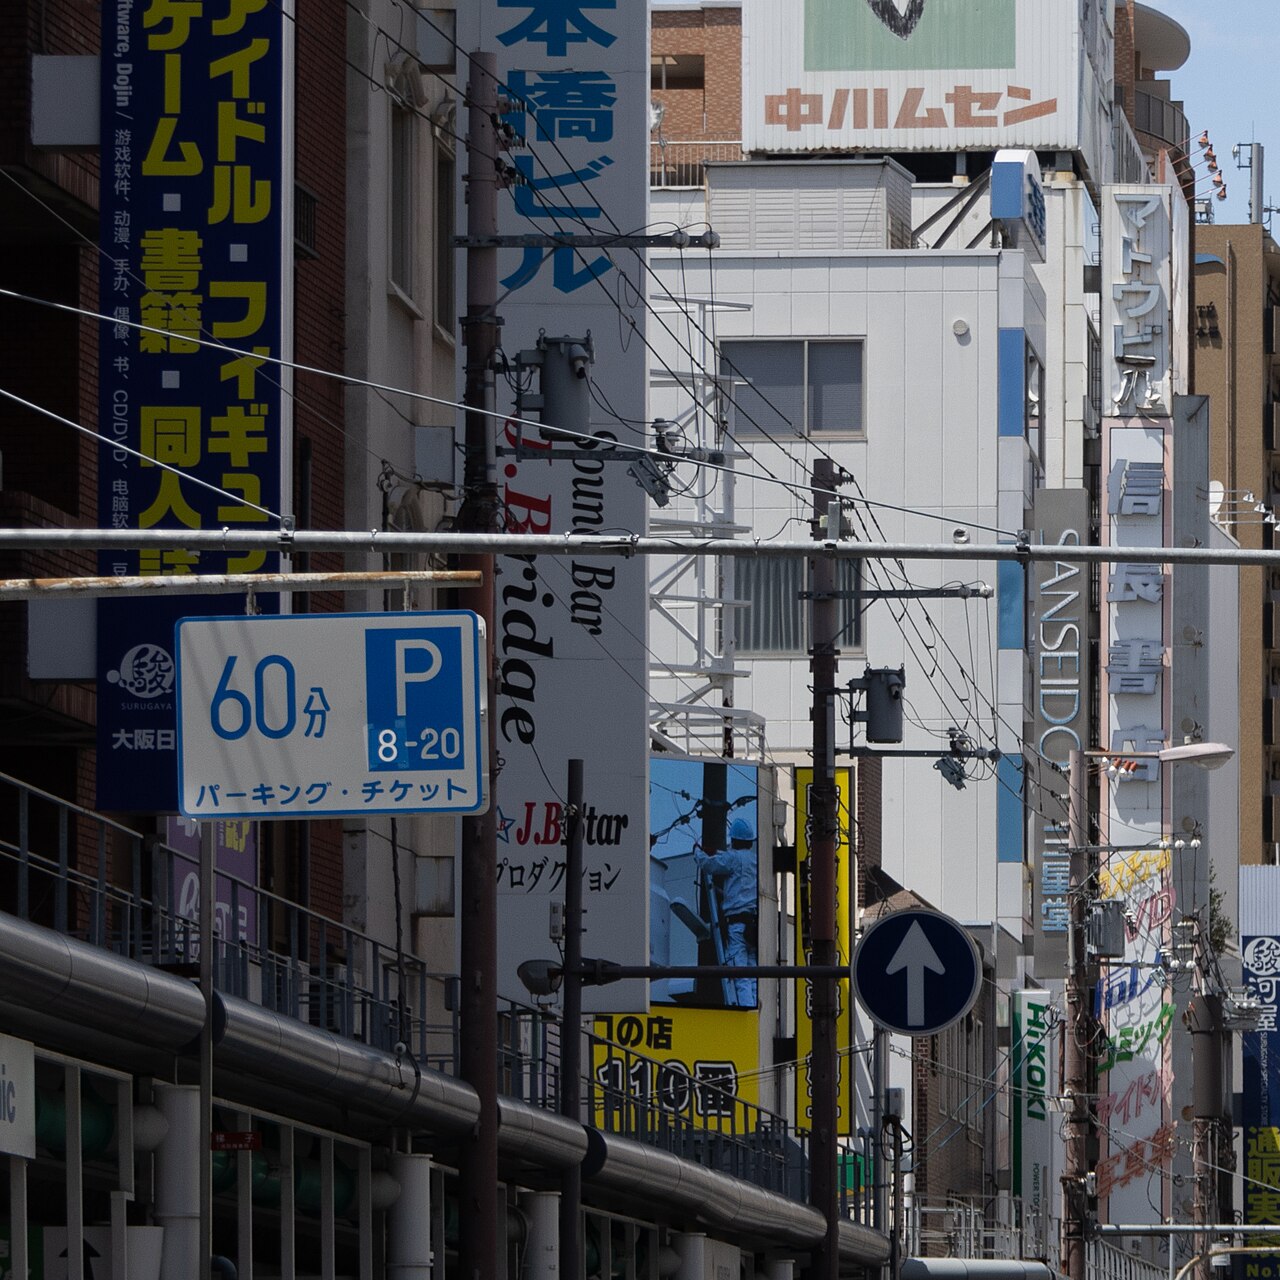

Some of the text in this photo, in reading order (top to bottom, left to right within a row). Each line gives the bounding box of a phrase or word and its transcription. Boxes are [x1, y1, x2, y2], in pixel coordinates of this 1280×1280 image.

[116, 63, 133, 107] Dojin
[764, 84, 1058, 131] 中川ムセン
[571, 560, 616, 635] Bar
[210, 654, 331, 741] 60分
[395, 639, 442, 717] P
[121, 702, 173, 712] SURUGAYA
[378, 726, 461, 763] 8-20
[196, 778, 469, 807] パーキング・チケット
[497, 855, 622, 894] プロダクョン
